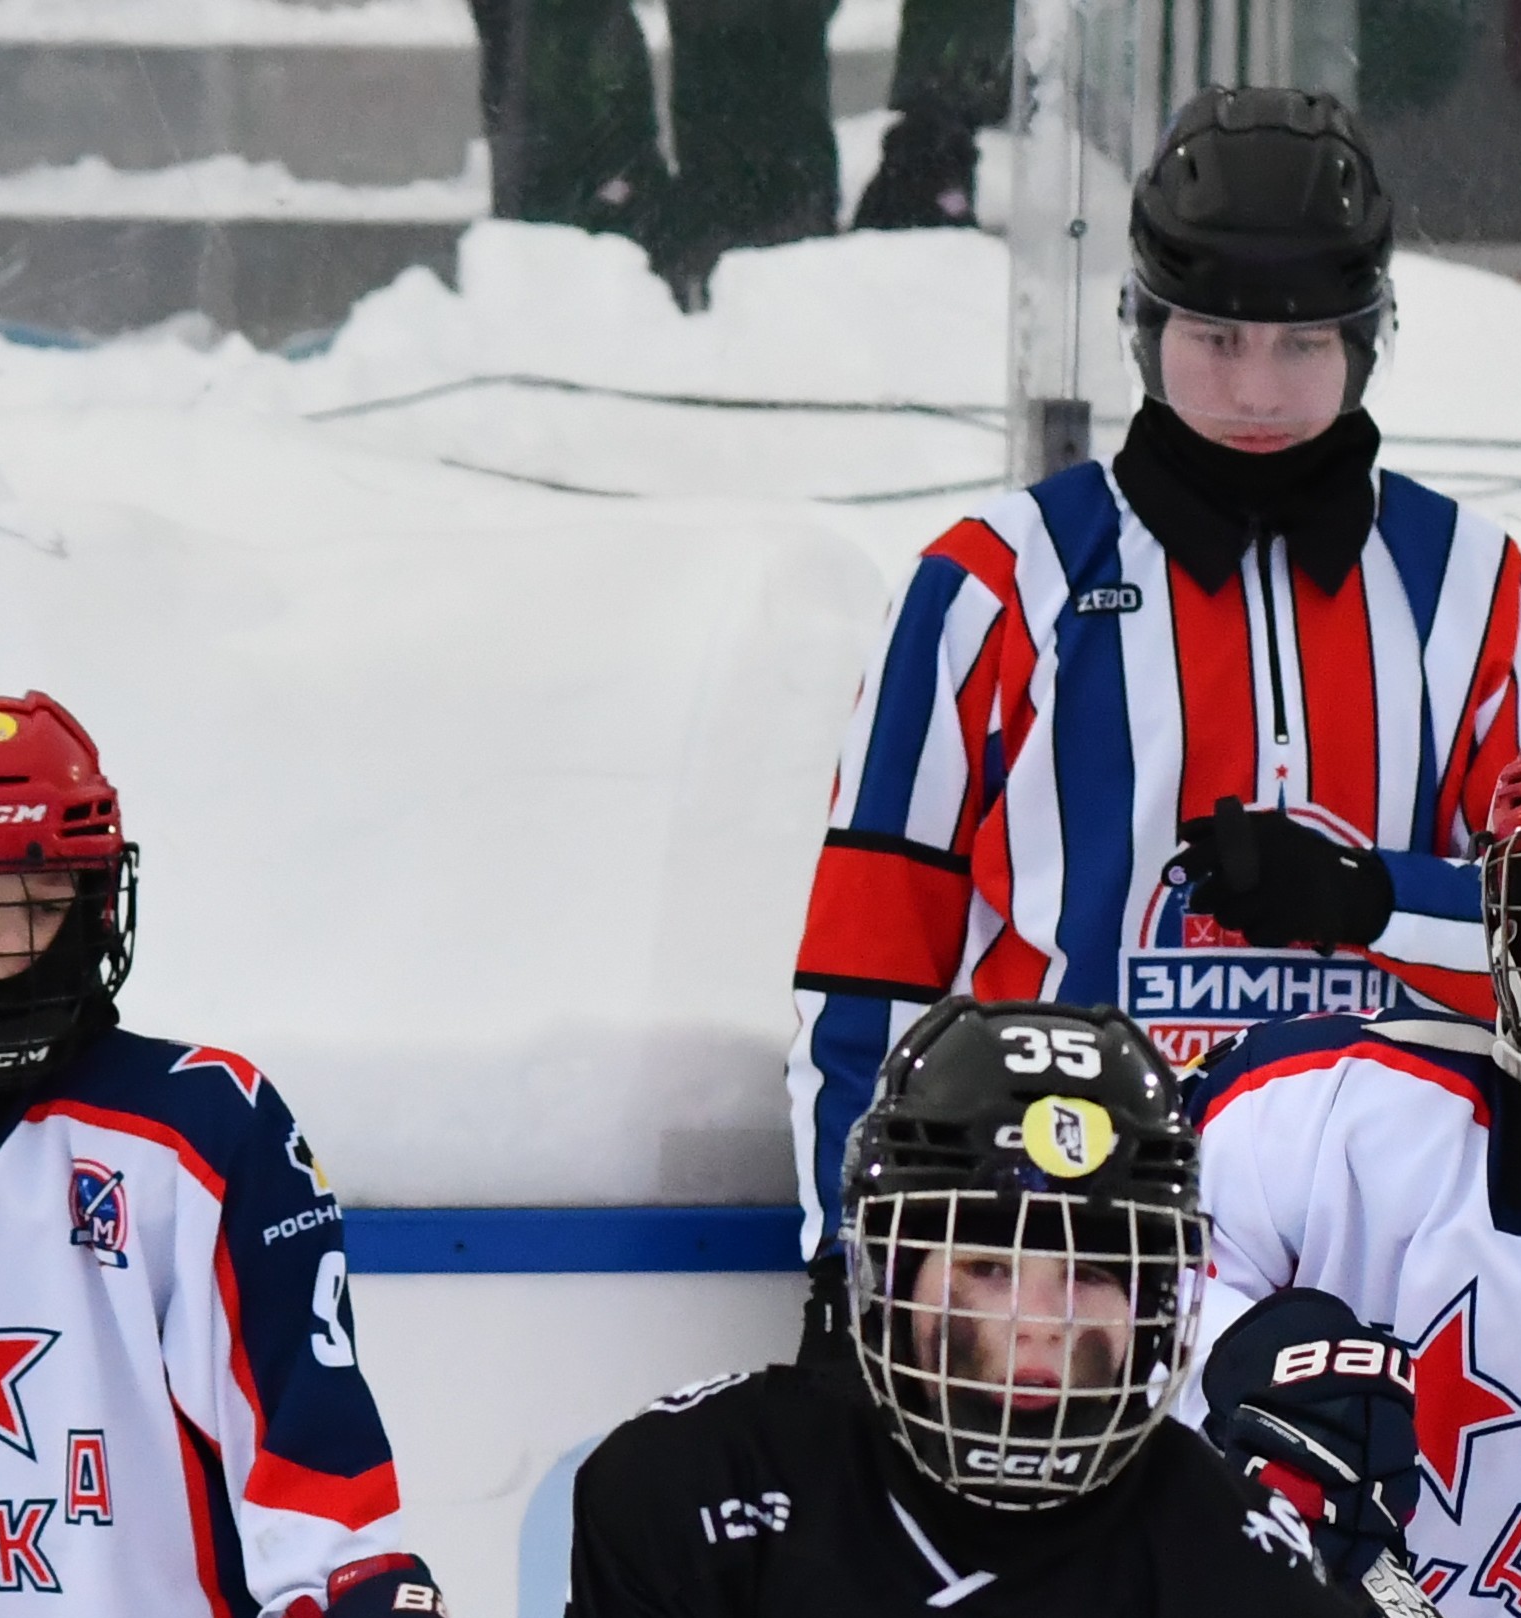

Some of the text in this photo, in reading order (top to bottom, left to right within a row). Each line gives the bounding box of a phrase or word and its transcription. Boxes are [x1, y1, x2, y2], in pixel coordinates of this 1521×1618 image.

[1001, 1026, 1102, 1080] 35
[1271, 1339, 1416, 1395] BAU
[965, 1448, 1082, 1477] CCM
